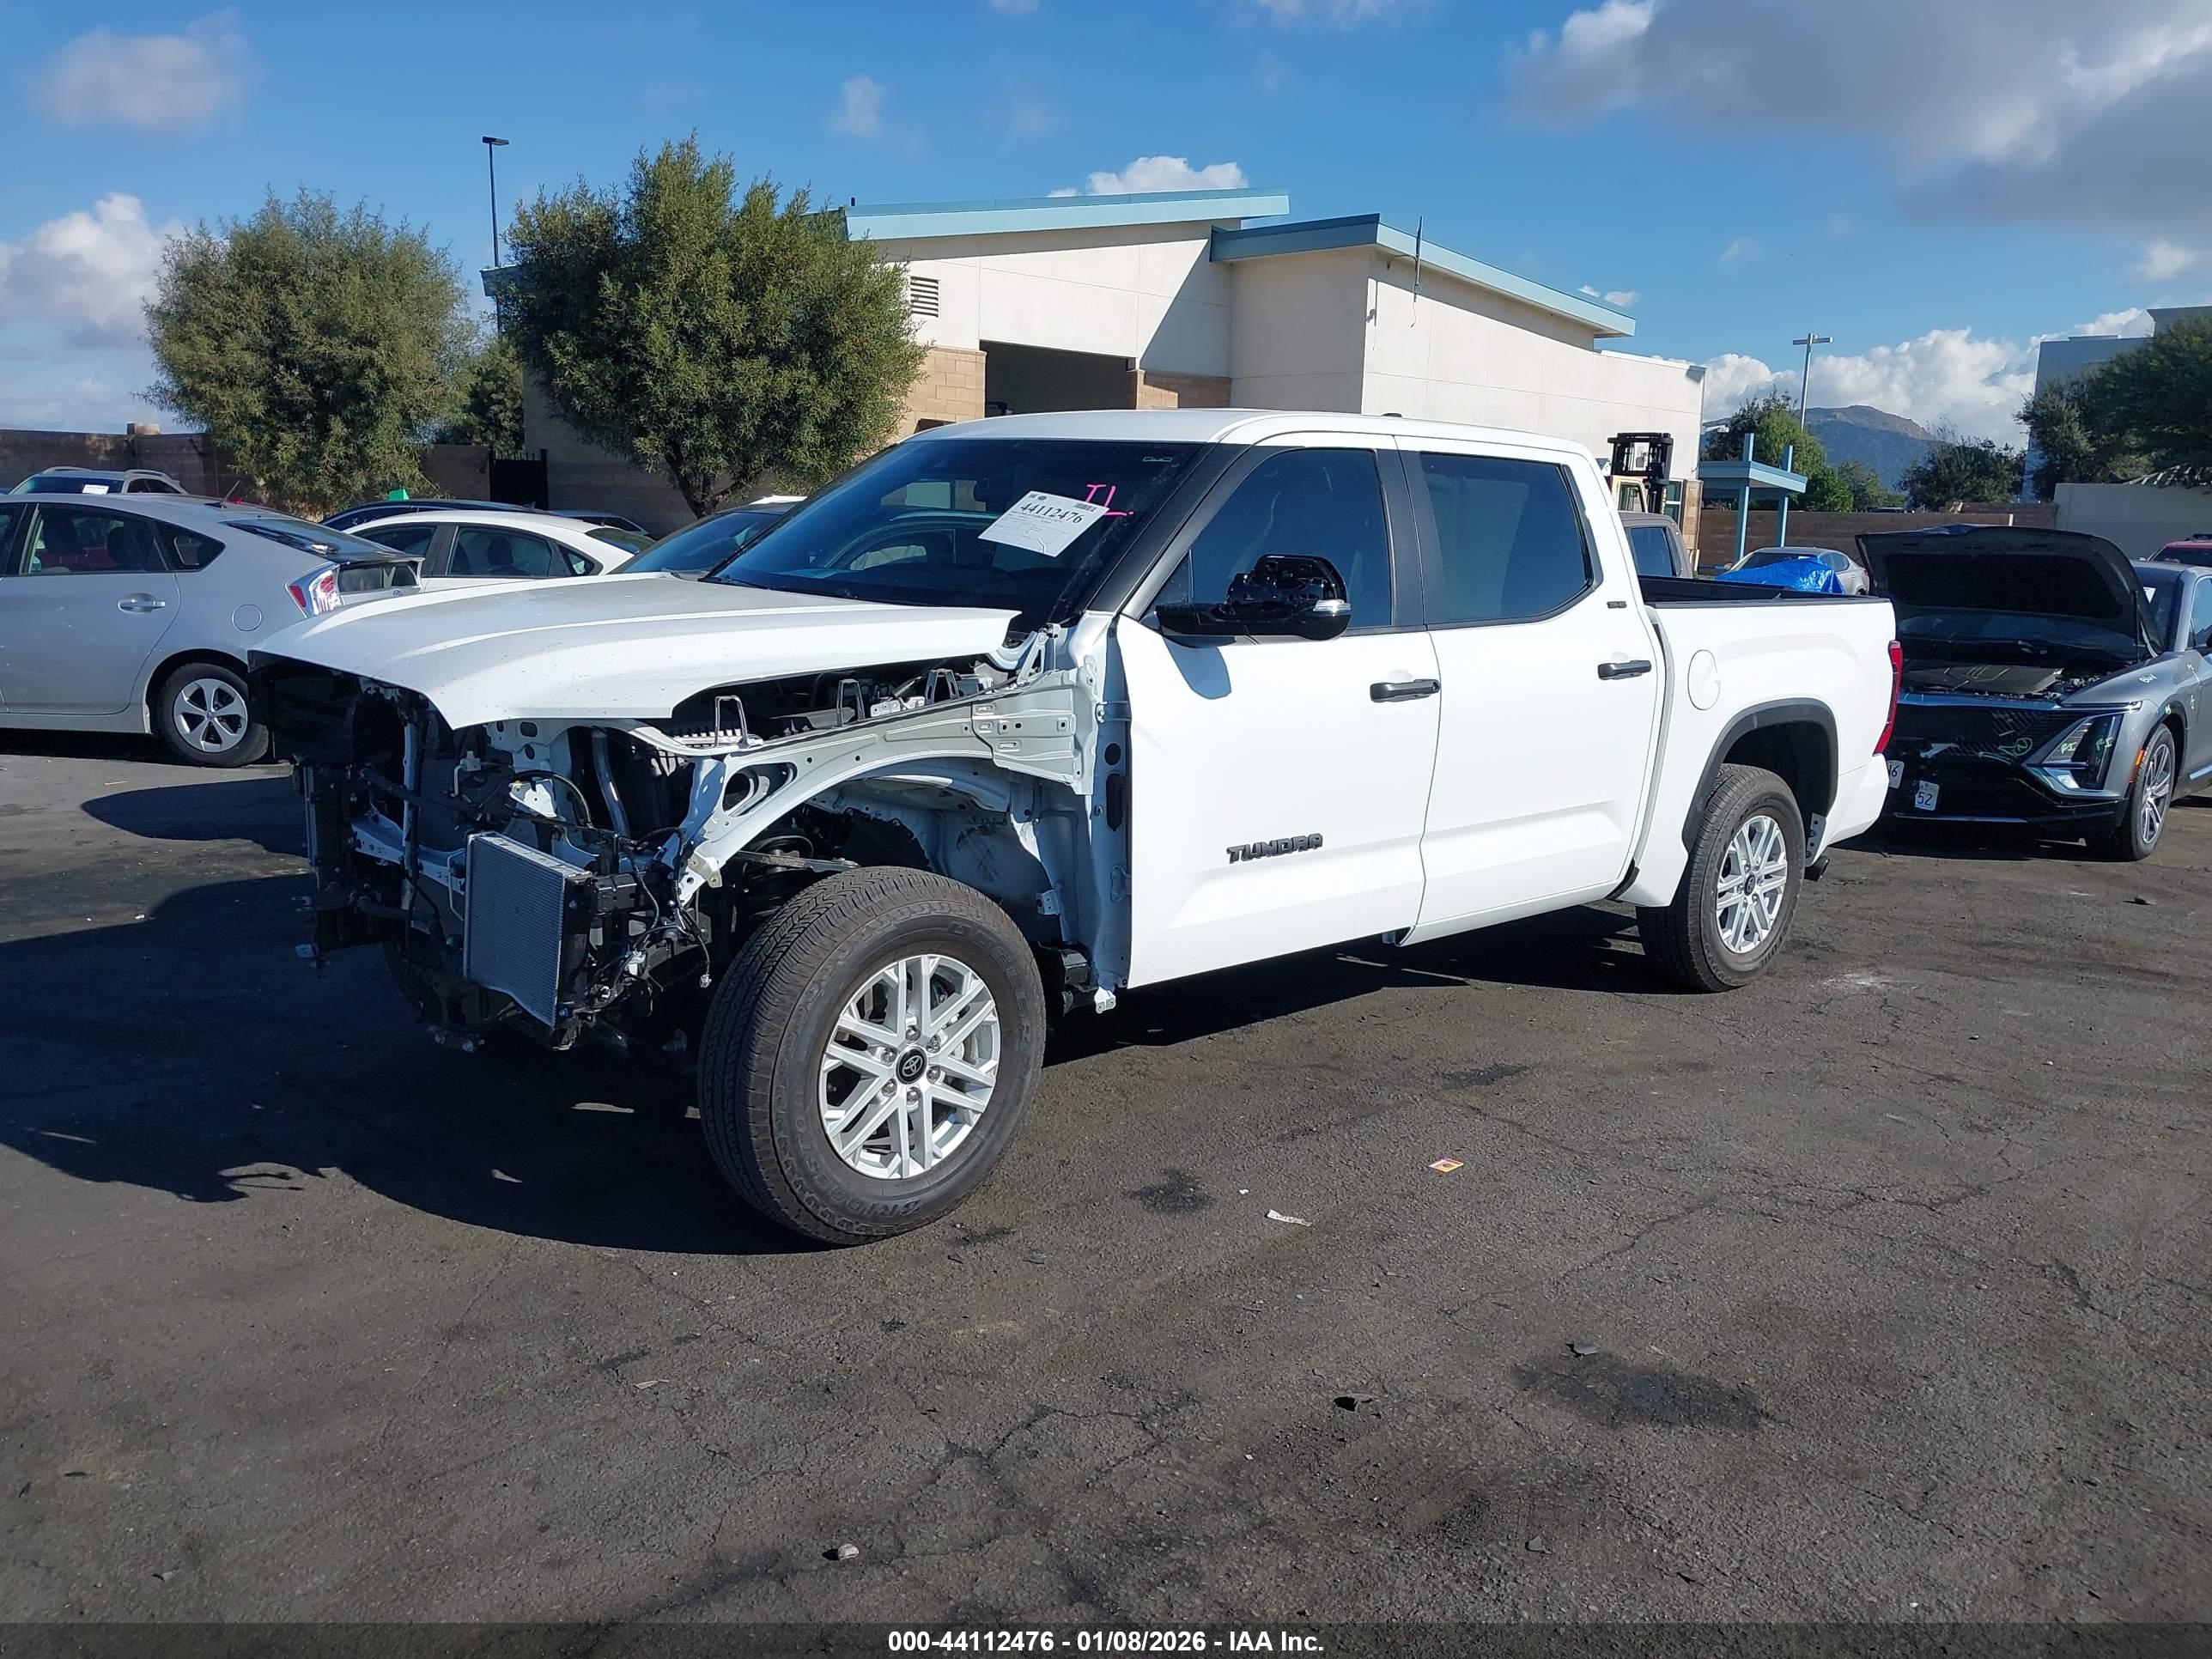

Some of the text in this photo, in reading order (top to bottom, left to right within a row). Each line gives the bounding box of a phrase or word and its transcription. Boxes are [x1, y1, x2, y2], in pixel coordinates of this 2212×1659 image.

[1019, 501, 1086, 524] 44112476
[1917, 791, 1934, 806] 52
[1225, 832, 1324, 865] TUNDRA
